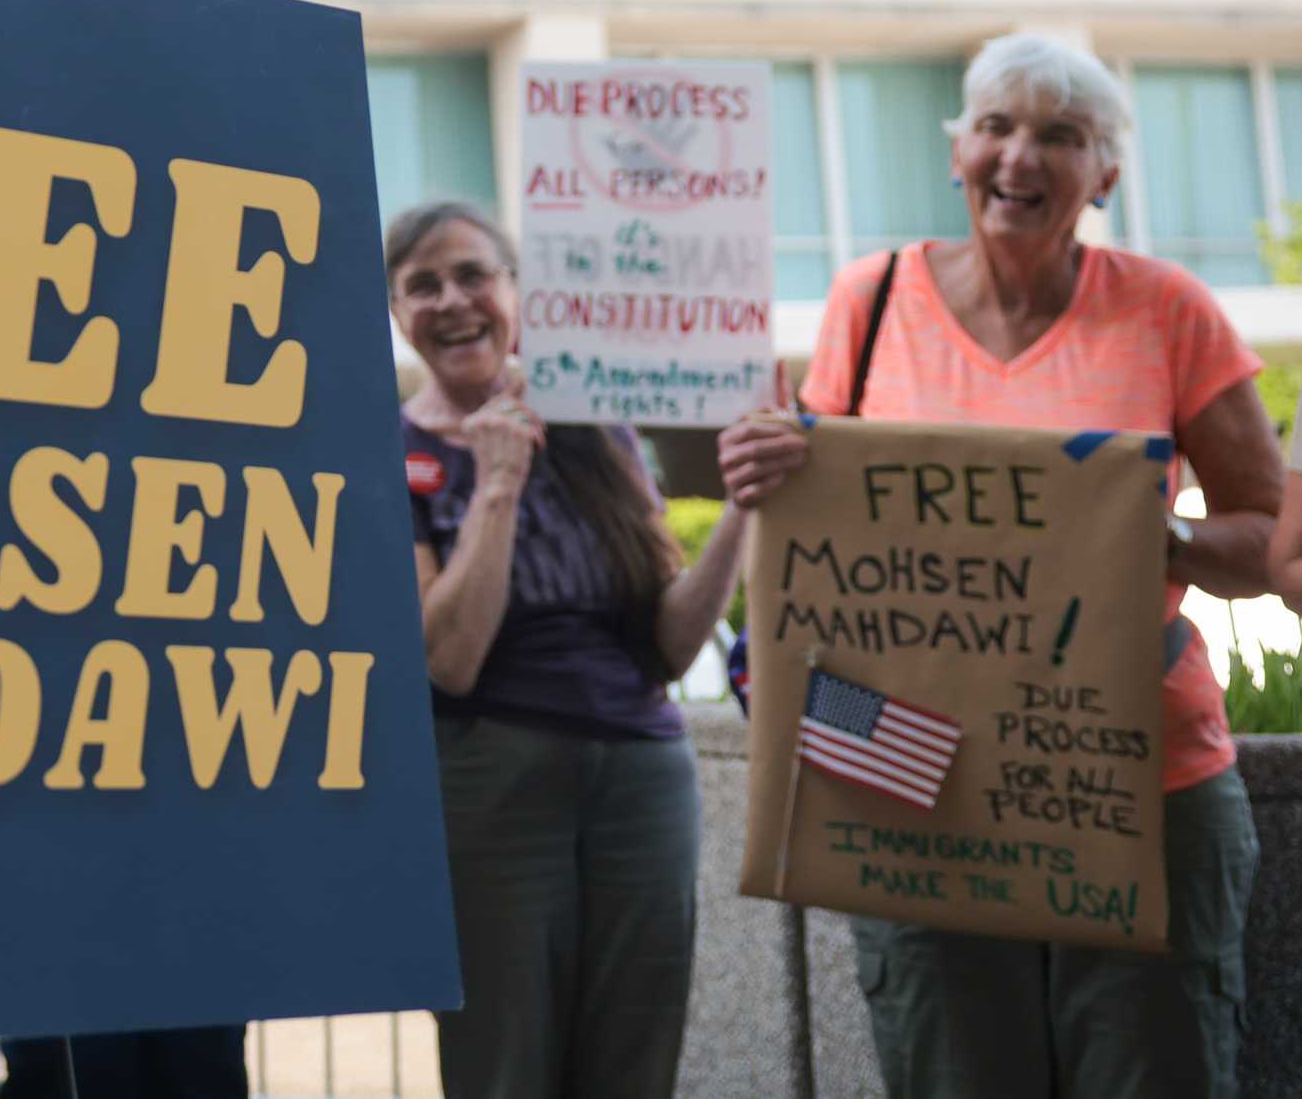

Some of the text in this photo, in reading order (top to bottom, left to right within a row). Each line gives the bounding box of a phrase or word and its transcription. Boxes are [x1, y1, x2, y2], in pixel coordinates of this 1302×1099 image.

[527, 76, 751, 122] DUE PROCESS
[527, 165, 586, 197] ALL
[525, 289, 769, 333] CONSTITUTION
[585, 357, 764, 390] Amendment
[864, 463, 1047, 529] FREE
[780, 537, 1032, 601] MOHSEN
[1013, 681, 1110, 716] DUE
[992, 710, 1150, 762] PROCESS
[999, 759, 1136, 802] FOR ALL
[983, 787, 1144, 838] PEOPLE
[825, 820, 1076, 876] IMMIGRANTS
[859, 861, 1140, 935] MAKE THE USA!
